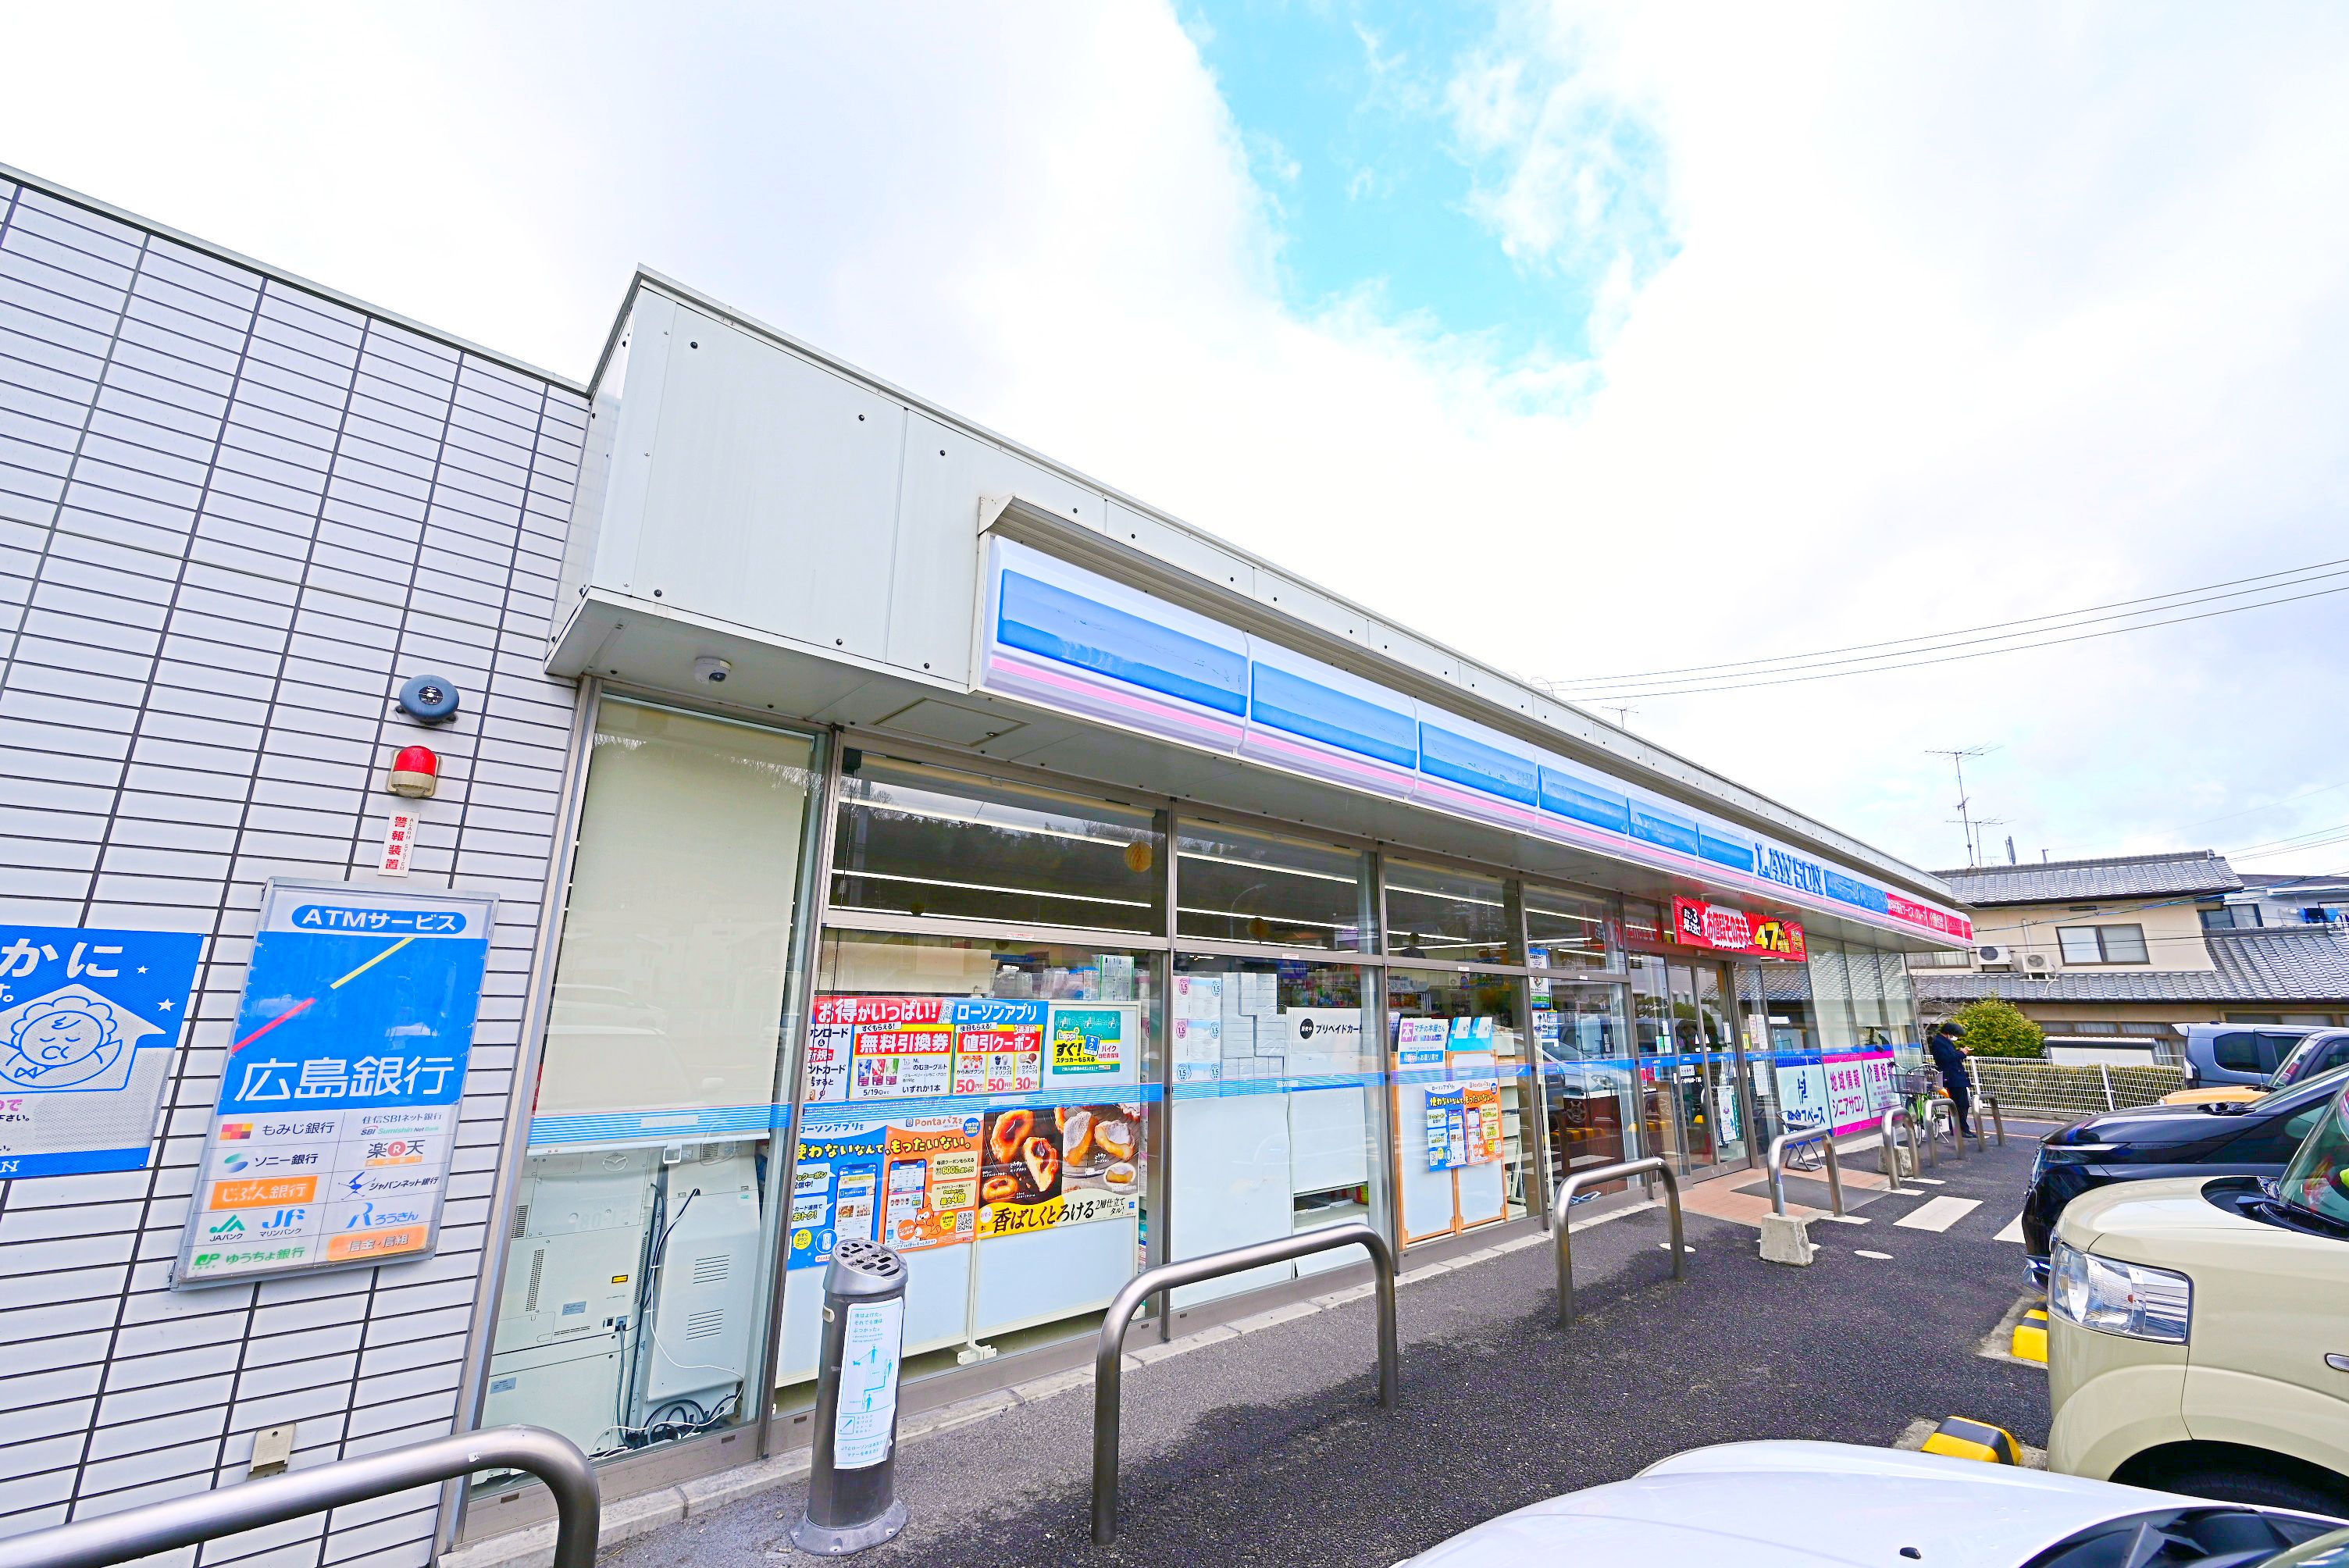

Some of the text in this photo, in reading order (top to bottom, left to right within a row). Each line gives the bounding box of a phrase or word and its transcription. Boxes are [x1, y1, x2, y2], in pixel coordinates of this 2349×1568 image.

[385, 816, 408, 870] 警報装置
[1755, 842, 1824, 896] LAWSON
[301, 909, 457, 931] ATMサービス
[1707, 911, 1749, 946] お値段そのまま
[0, 938, 123, 978] かに
[818, 998, 937, 1024] お得がいっぱい!
[957, 1003, 1038, 1022] ローソンアプリ
[861, 1023, 896, 1032] すぐもらえる!
[960, 1023, 993, 1032] 後日もらえる!
[1402, 1023, 1413, 1041] 本
[1414, 1023, 1445, 1033] マチの本屋さん
[859, 1033, 949, 1053] 無料引換券
[963, 1034, 1035, 1053] 値引クーポン
[1056, 1042, 1083, 1057] すぐ!
[235, 1056, 454, 1102] 広島銀行
[902, 1084, 941, 1093] いずれか1本
[1830, 1069, 1861, 1092] 地域情報
[1833, 1095, 1865, 1118] シニアサロン
[262, 1121, 335, 1135] もみじ銀行
[362, 1113, 442, 1124] 住信SBIネット銀行
[914, 1116, 963, 1127] Pontaパスを
[255, 1153, 319, 1167] ソニー銀行
[223, 1183, 307, 1203] じぶん銀行
[369, 1176, 440, 1192] ジャパンネット銀行
[940, 1193, 966, 1206] 最大4倍
[1095, 1197, 1126, 1210] 2層仕立て
[375, 1210, 419, 1224] ろうきん
[993, 1199, 1094, 1234] 香ばしくとろける
[209, 1232, 243, 1242] JAバンク
[259, 1228, 302, 1238] マリンバンク
[349, 1234, 409, 1253] 信金・信組
[225, 1247, 306, 1266] ゆうちょ銀行
